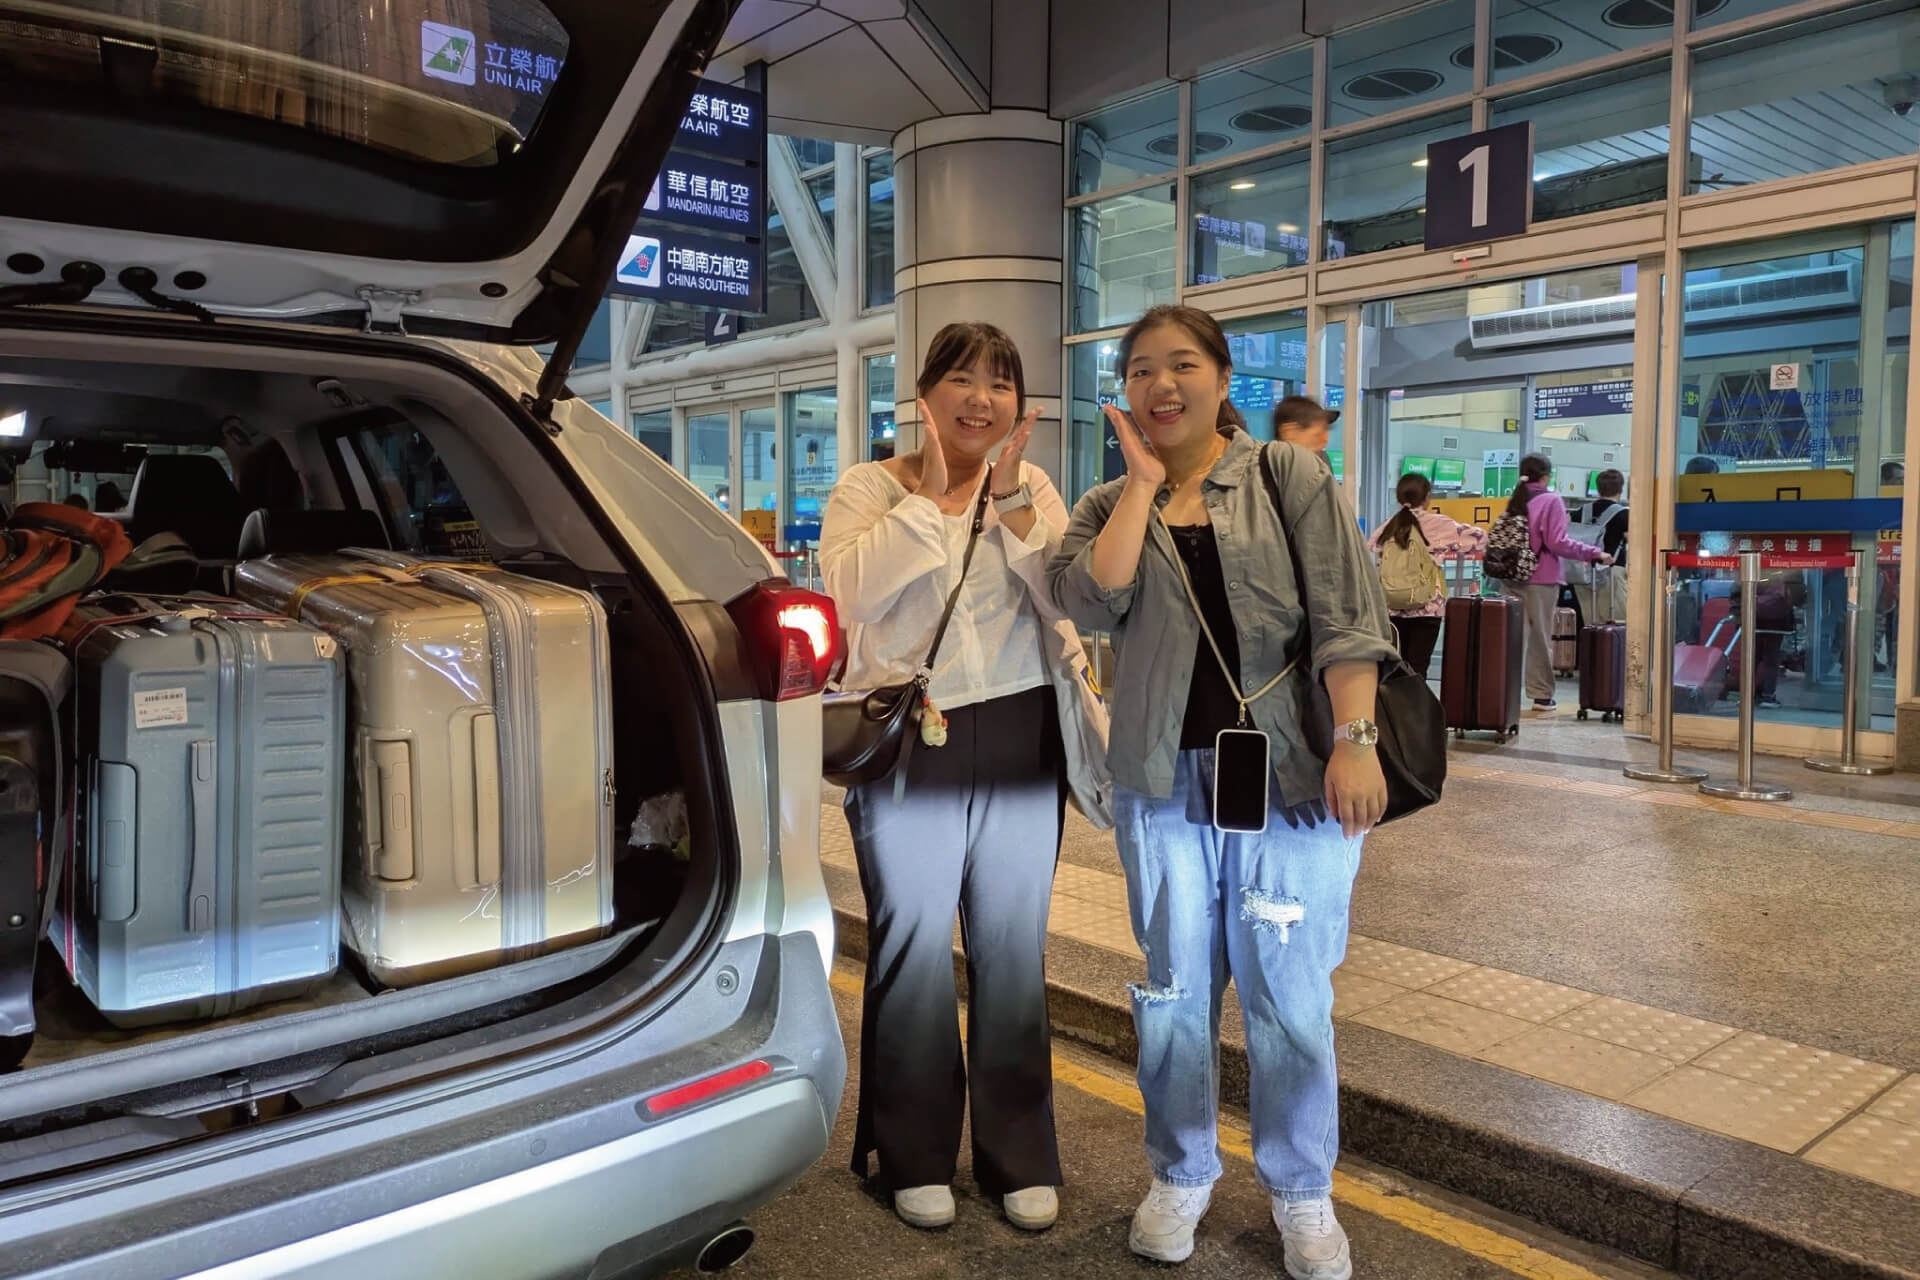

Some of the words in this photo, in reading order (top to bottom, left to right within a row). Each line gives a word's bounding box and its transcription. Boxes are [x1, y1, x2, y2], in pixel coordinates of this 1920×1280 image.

[484, 42, 565, 82] 立榮航
[484, 68, 512, 88] UNI
[515, 75, 543, 95] AIR
[695, 119, 719, 136] AIR
[667, 170, 750, 206] 華信航空
[1458, 144, 1491, 228] 1
[667, 195, 712, 215] MANDARIN
[712, 204, 749, 223] AIRLINES
[667, 246, 750, 280] 中國南方航空
[667, 272, 697, 289] CHINA
[699, 277, 749, 296] SOUTHERN
